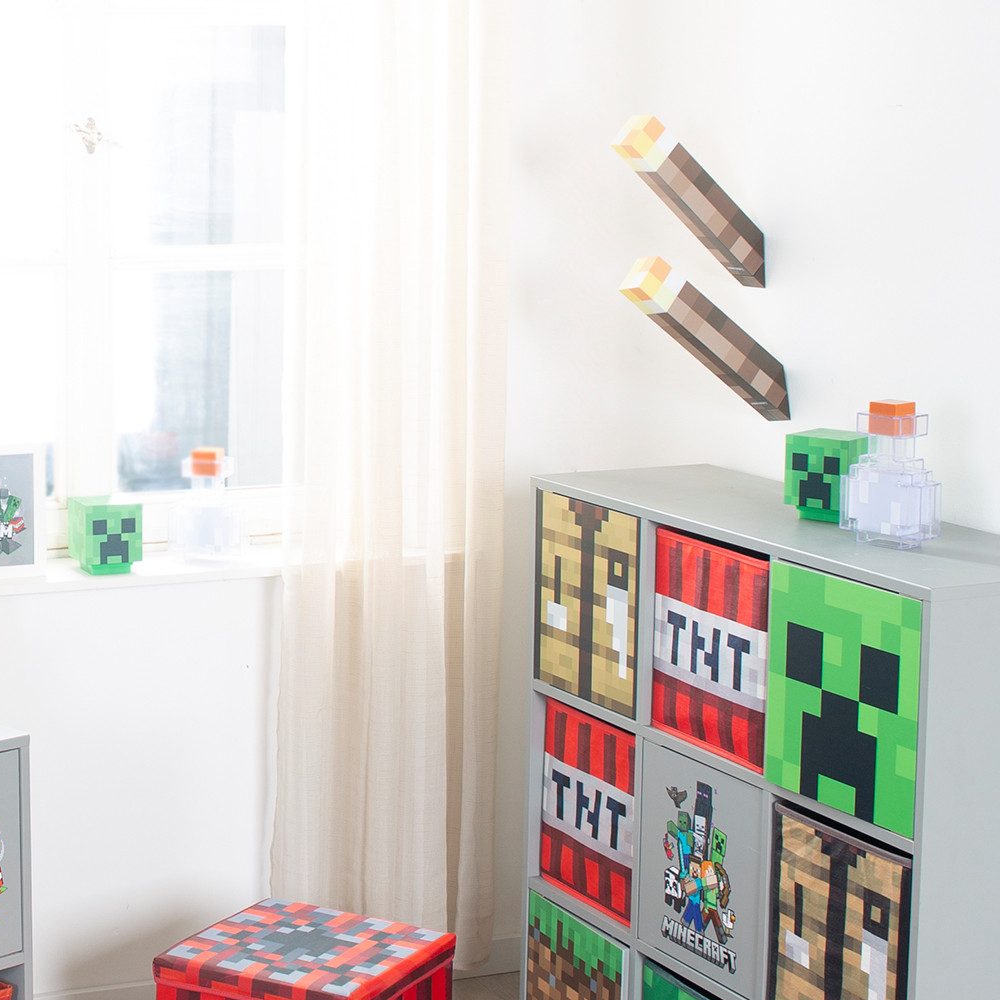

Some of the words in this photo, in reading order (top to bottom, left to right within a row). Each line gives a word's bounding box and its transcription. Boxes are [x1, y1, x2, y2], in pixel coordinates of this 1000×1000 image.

[667, 609, 751, 692] TNT
[552, 768, 627, 850] TNT
[661, 914, 737, 975] MINECRAFT
